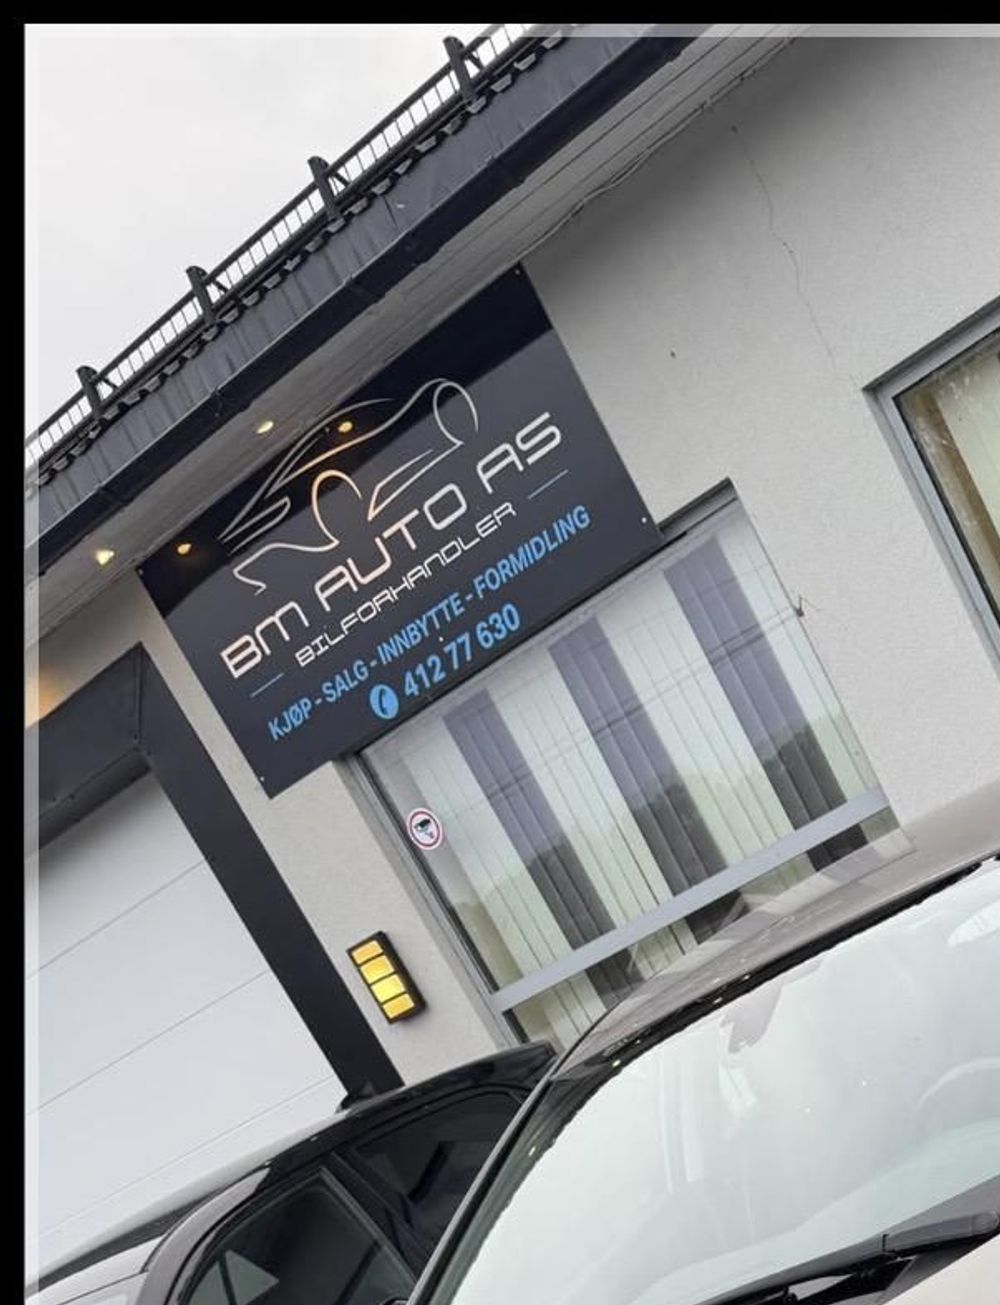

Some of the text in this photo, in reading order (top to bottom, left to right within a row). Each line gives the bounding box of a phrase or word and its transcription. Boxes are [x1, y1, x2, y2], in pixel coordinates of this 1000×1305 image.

[220, 411, 562, 679] BM AUTO AS
[268, 697, 312, 740] KJØP
[322, 660, 369, 703] SALG
[377, 592, 465, 665] INNBYTTE
[473, 505, 590, 599] FORMIDLING
[295, 502, 517, 667] BILFORHANDLER
[404, 603, 520, 696] 412 77 630
